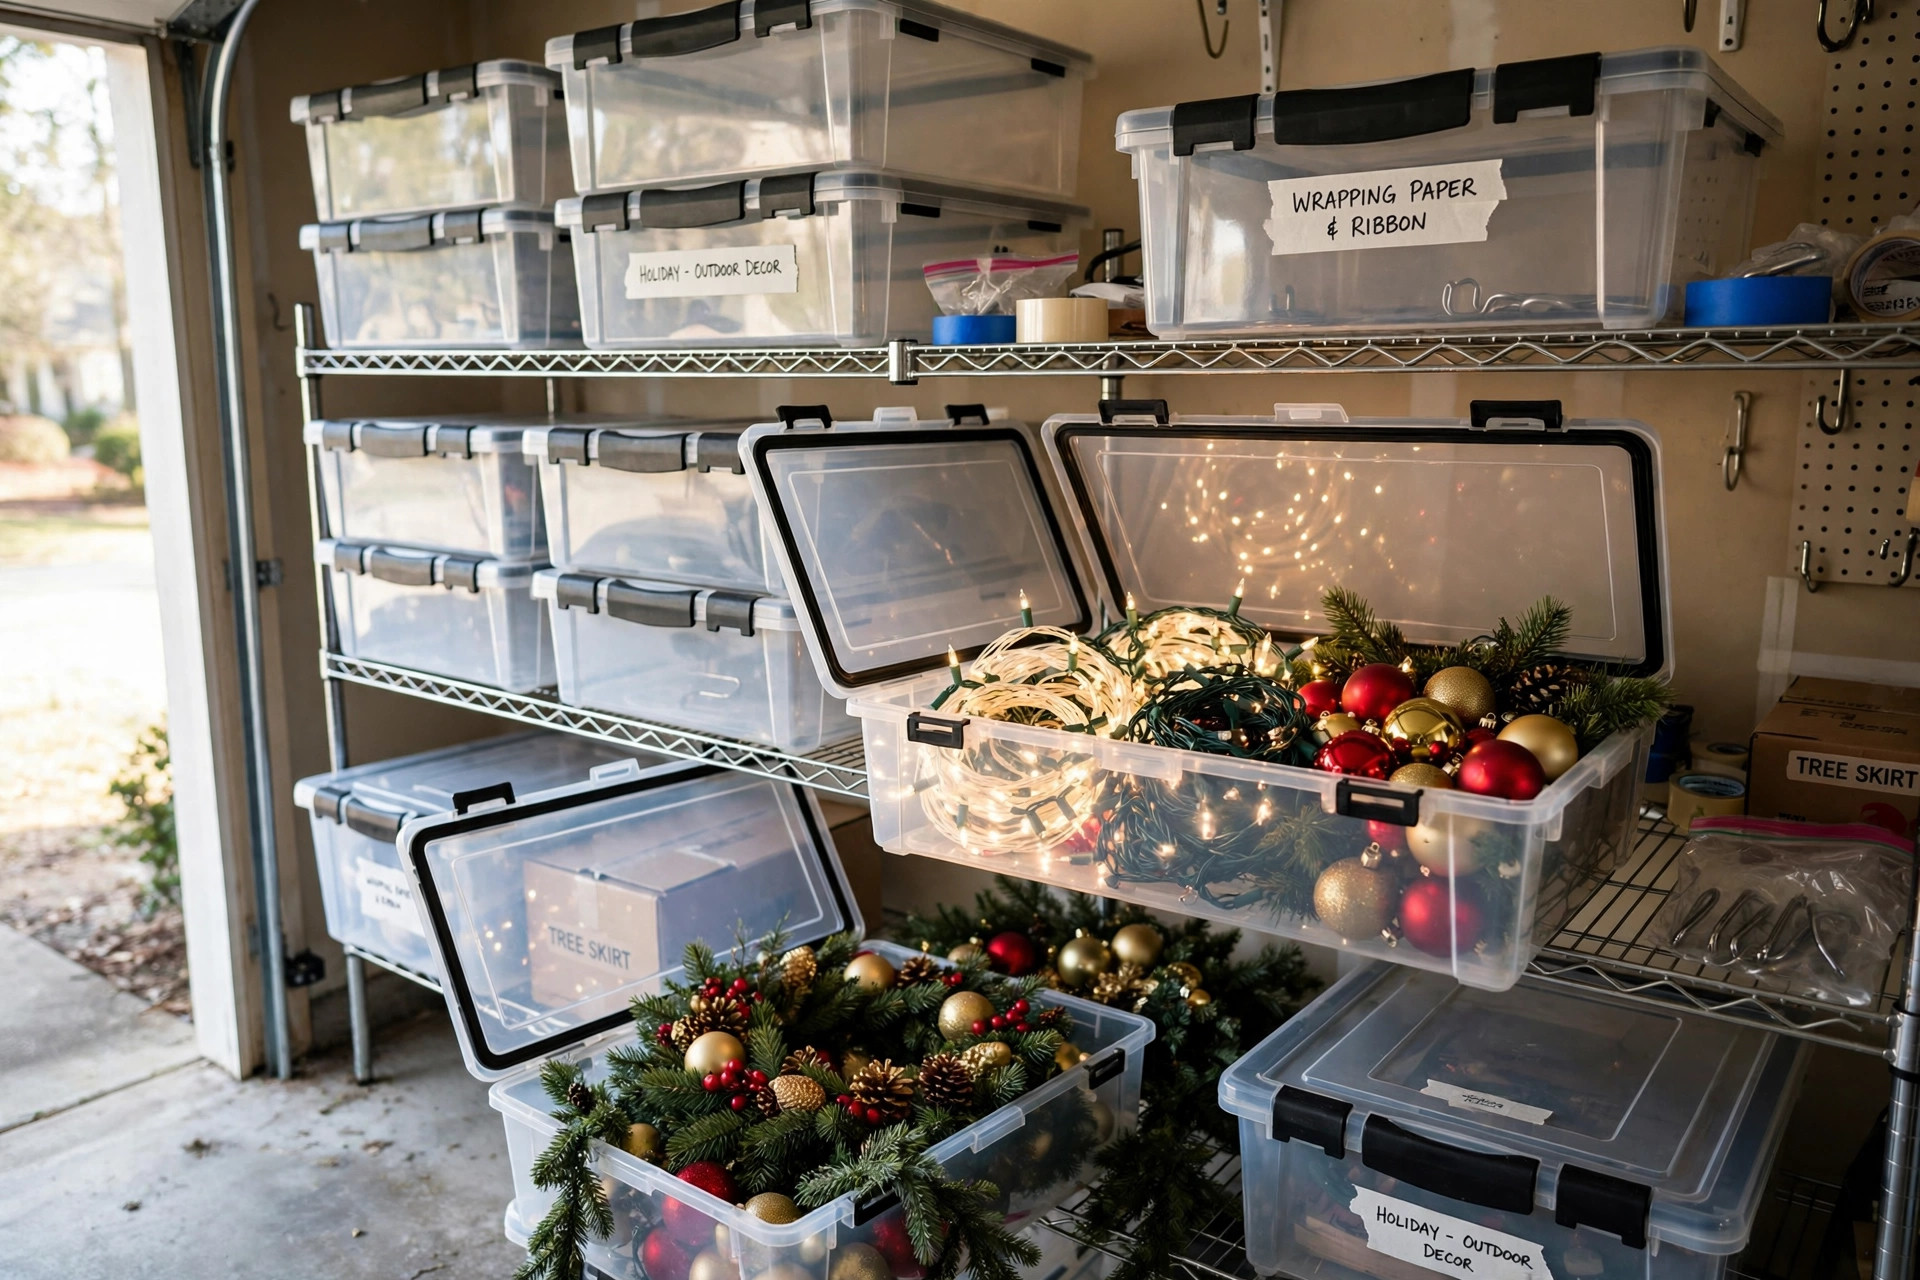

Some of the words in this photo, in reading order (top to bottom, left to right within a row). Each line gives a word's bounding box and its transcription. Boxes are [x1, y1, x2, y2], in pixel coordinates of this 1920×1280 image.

[1292, 185, 1397, 213] WRAPPING
[1409, 177, 1478, 202] PAPER
[1326, 216, 1339, 241] &
[1351, 212, 1427, 238] RIBBON
[639, 264, 681, 284] HOLIDAY
[694, 262, 742, 279] OUTDOOR
[745, 259, 782, 276] DECOR
[1796, 756, 1849, 780] TREE
[1855, 764, 1919, 789] SKIRT
[548, 925, 585, 956] TREE
[588, 940, 631, 970] SKIRT
[1376, 1205, 1440, 1241] HOLIDAY
[1463, 1235, 1534, 1270] OUTDOOR
[1423, 1243, 1475, 1273] DECOR
